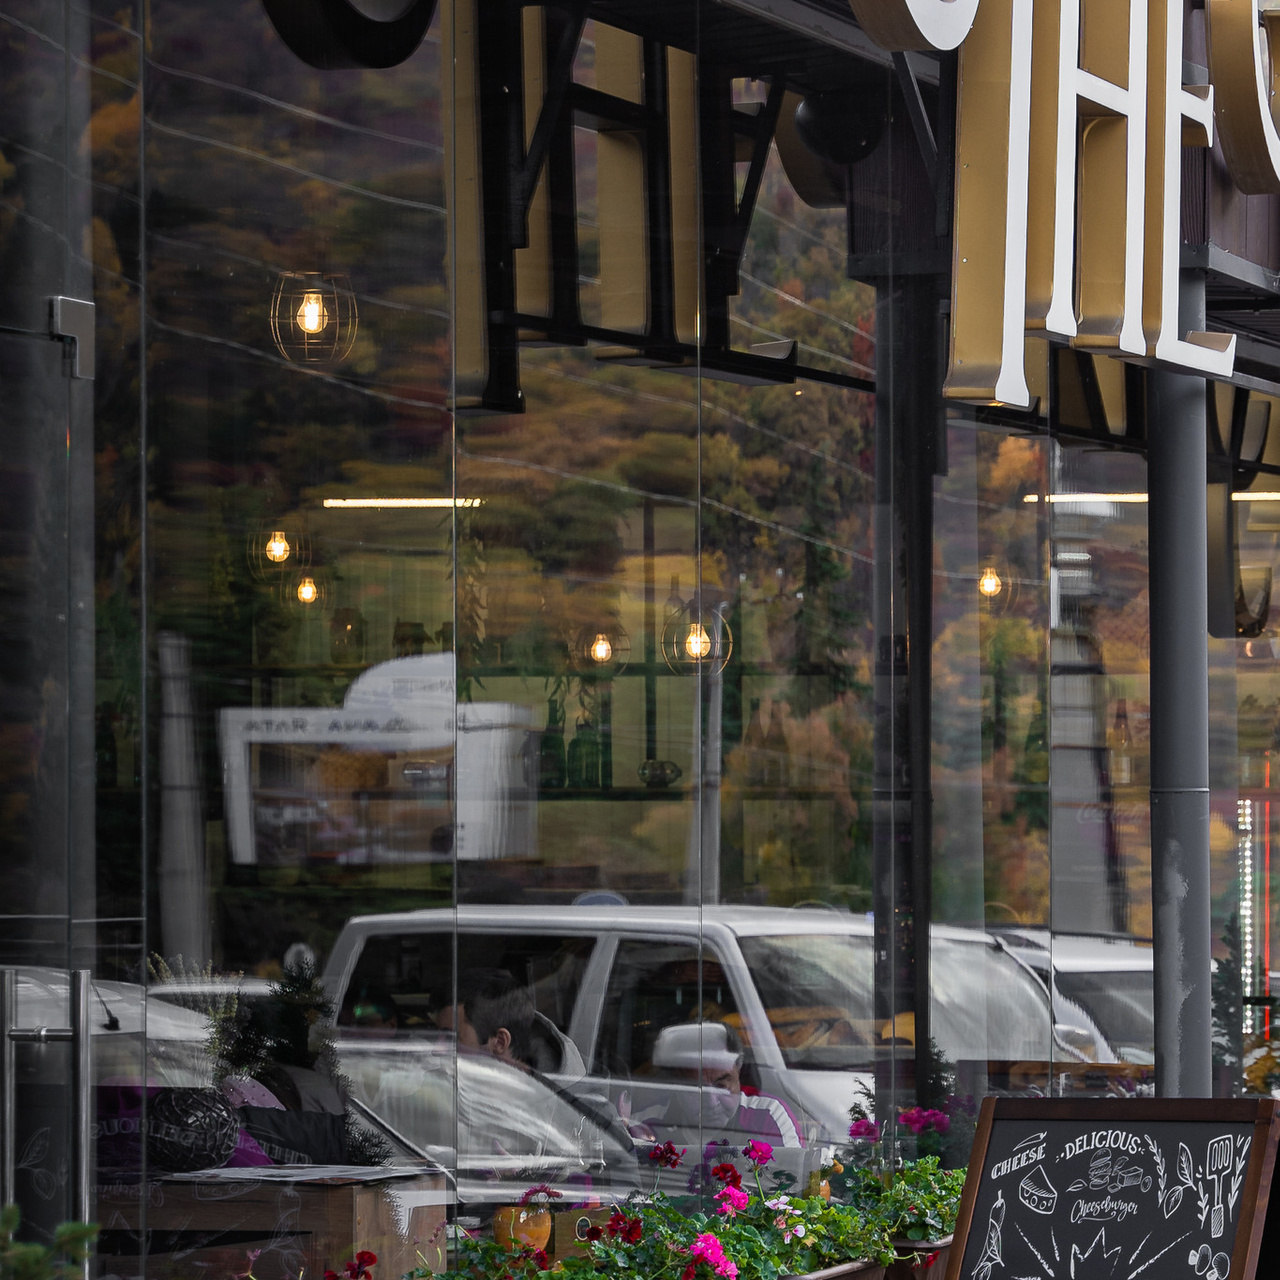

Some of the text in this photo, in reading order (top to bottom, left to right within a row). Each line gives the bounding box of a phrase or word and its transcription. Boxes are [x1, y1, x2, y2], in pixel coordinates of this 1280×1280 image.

[1065, 1130, 1142, 1160] DELICIOUS
[991, 1143, 1047, 1179] CHEESE
[1070, 1195, 1138, 1224] Cheeseburger
